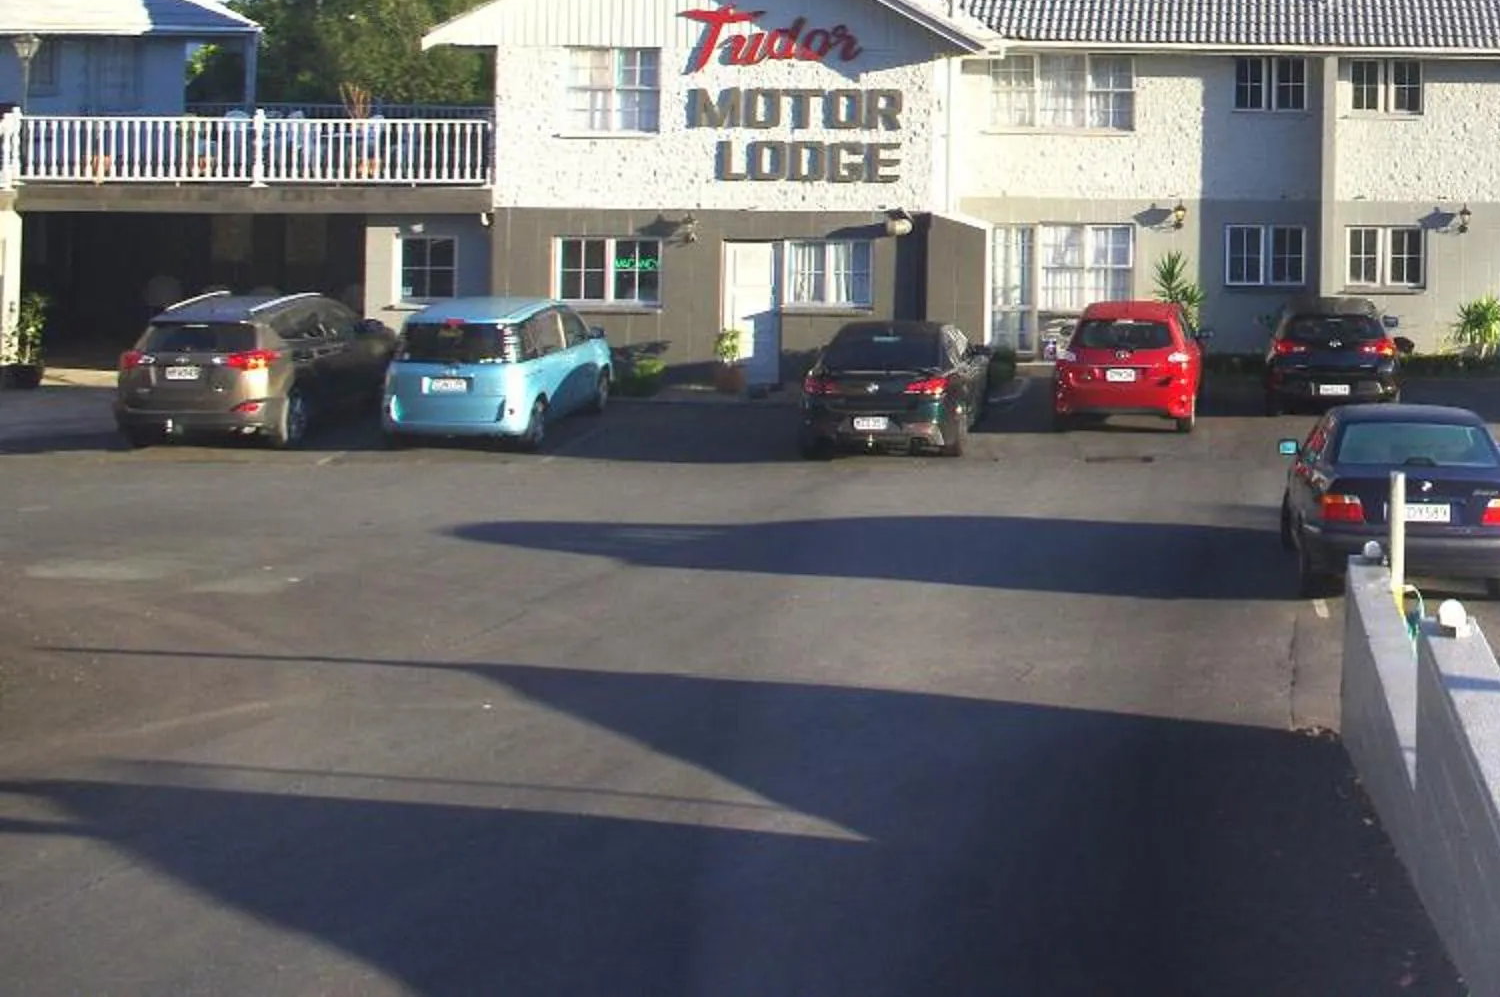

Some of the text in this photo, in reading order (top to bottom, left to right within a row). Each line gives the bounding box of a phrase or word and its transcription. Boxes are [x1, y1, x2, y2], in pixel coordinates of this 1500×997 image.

[676, 3, 861, 74] Tudor
[686, 88, 902, 130] MOTOR
[715, 141, 901, 183] LODGE
